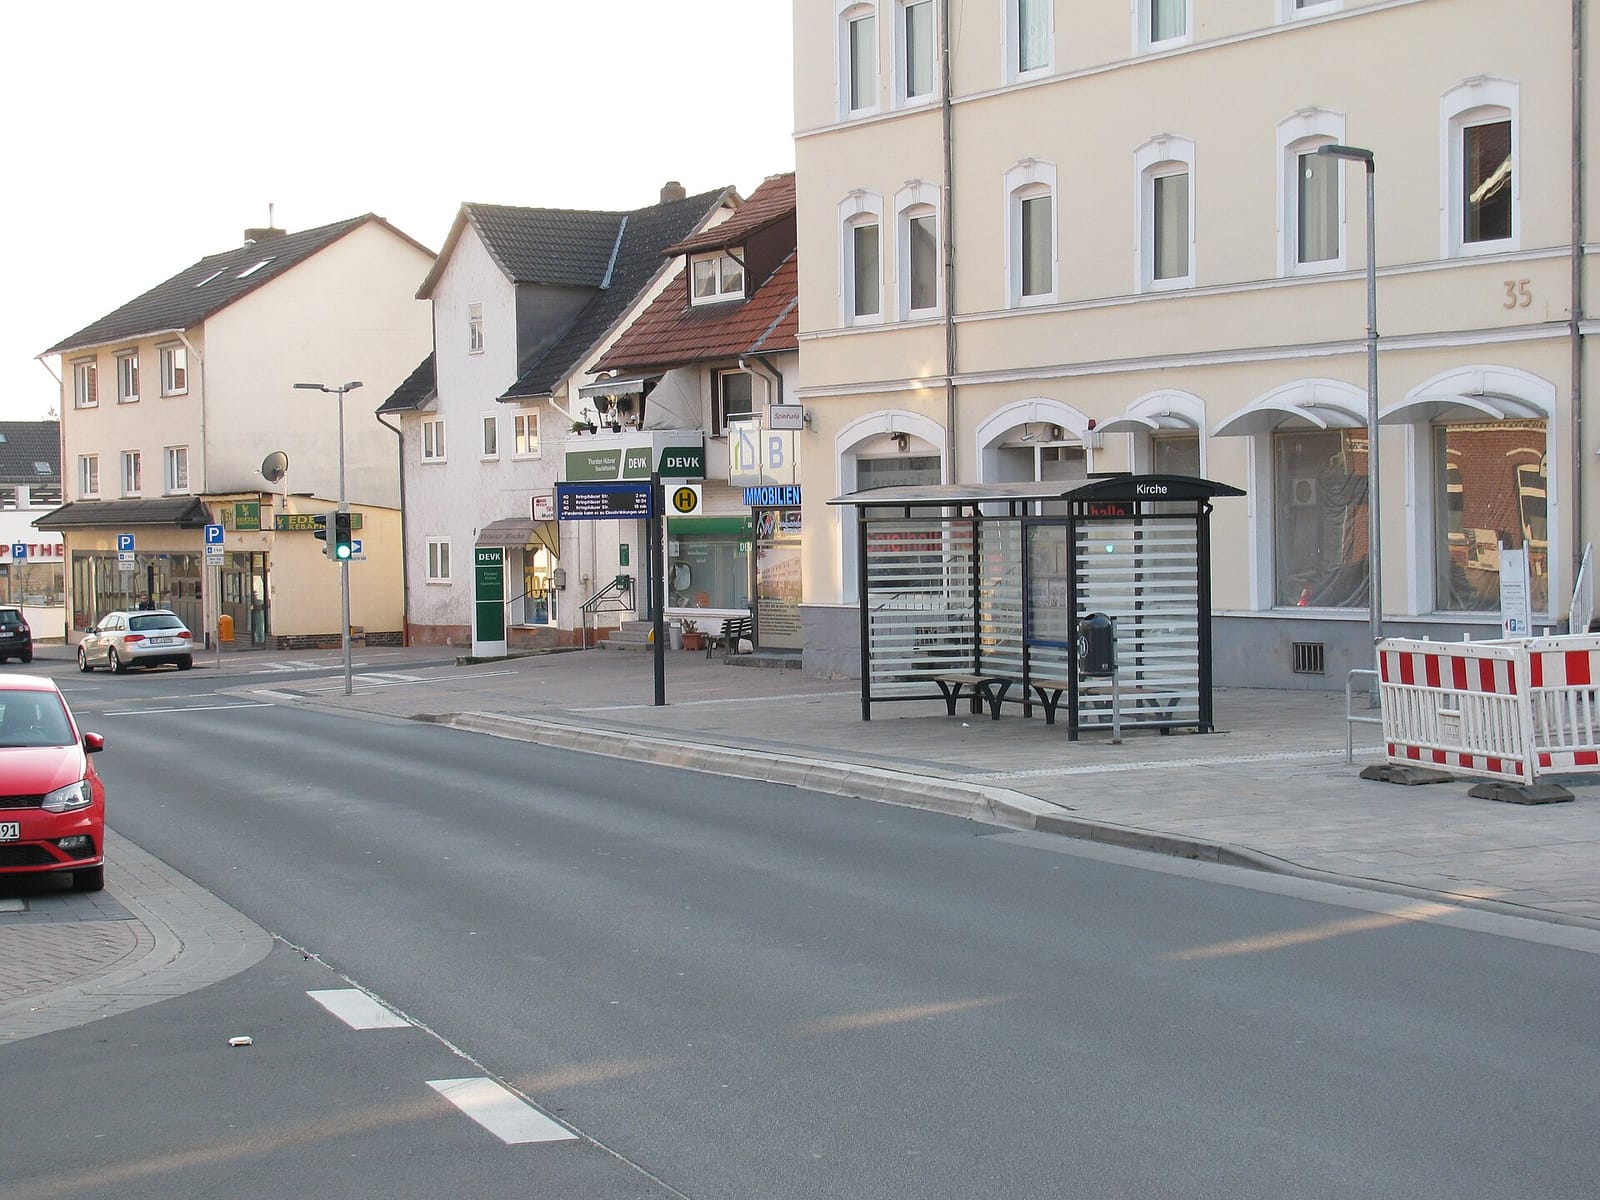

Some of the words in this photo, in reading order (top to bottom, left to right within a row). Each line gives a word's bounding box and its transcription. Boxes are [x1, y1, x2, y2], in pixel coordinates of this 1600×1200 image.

[1503, 279, 1532, 309] 35
[628, 457, 647, 469] DEVK
[667, 457, 700, 468] DEVK
[1136, 483, 1168, 494] Kirche
[743, 486, 800, 505] IMMOBILIEN
[289, 515, 317, 524] EDE
[210, 527, 219, 542] P
[121, 536, 131, 549] P
[478, 553, 501, 561] DEVK
